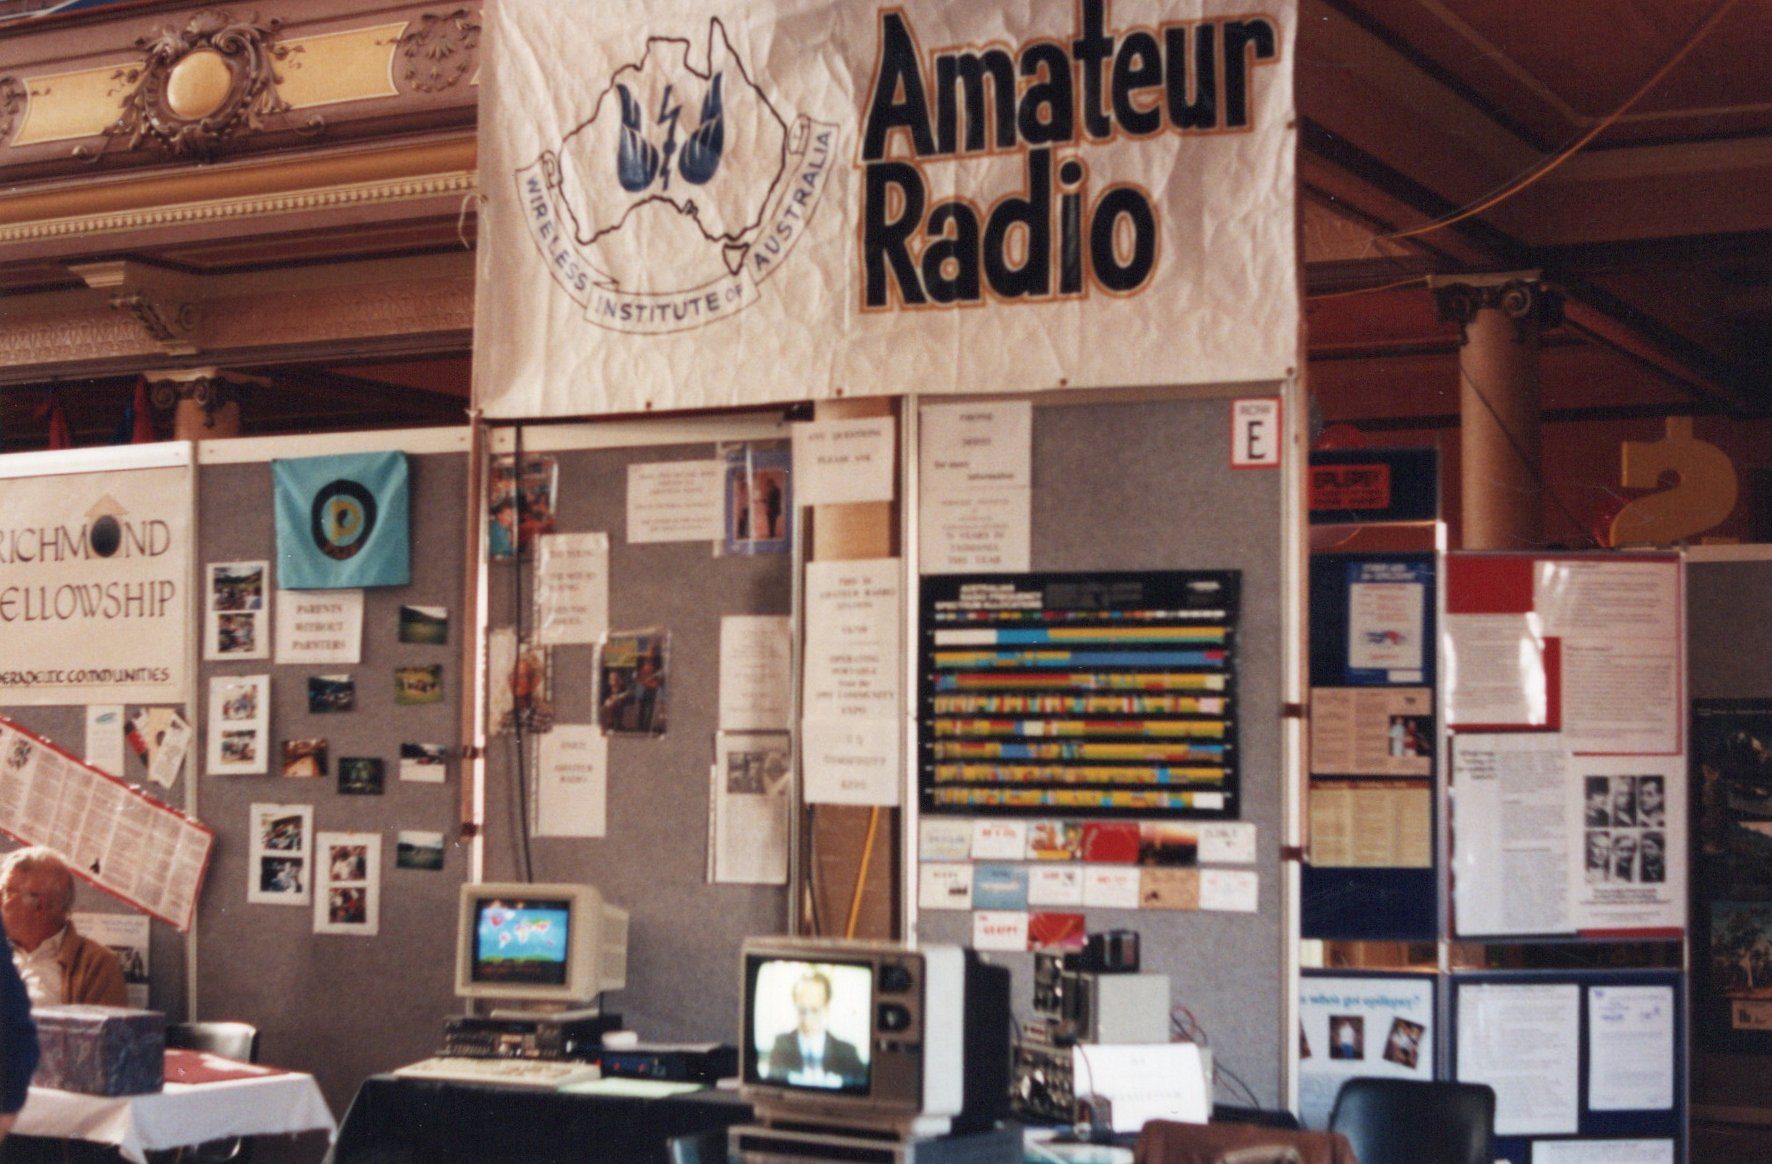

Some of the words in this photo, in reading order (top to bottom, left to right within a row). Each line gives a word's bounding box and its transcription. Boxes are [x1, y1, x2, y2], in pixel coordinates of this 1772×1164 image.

[860, 0, 1277, 163] Amateur
[525, 175, 590, 293] WIRELESS
[594, 290, 721, 323] INSTITUTE
[724, 283, 746, 304] OF
[752, 128, 833, 273] AUSTRALIA
[862, 146, 1158, 309] Radio
[1247, 420, 1266, 460] E
[294, 621, 344, 632] WITHOUT
[295, 604, 344, 614] PARENTS
